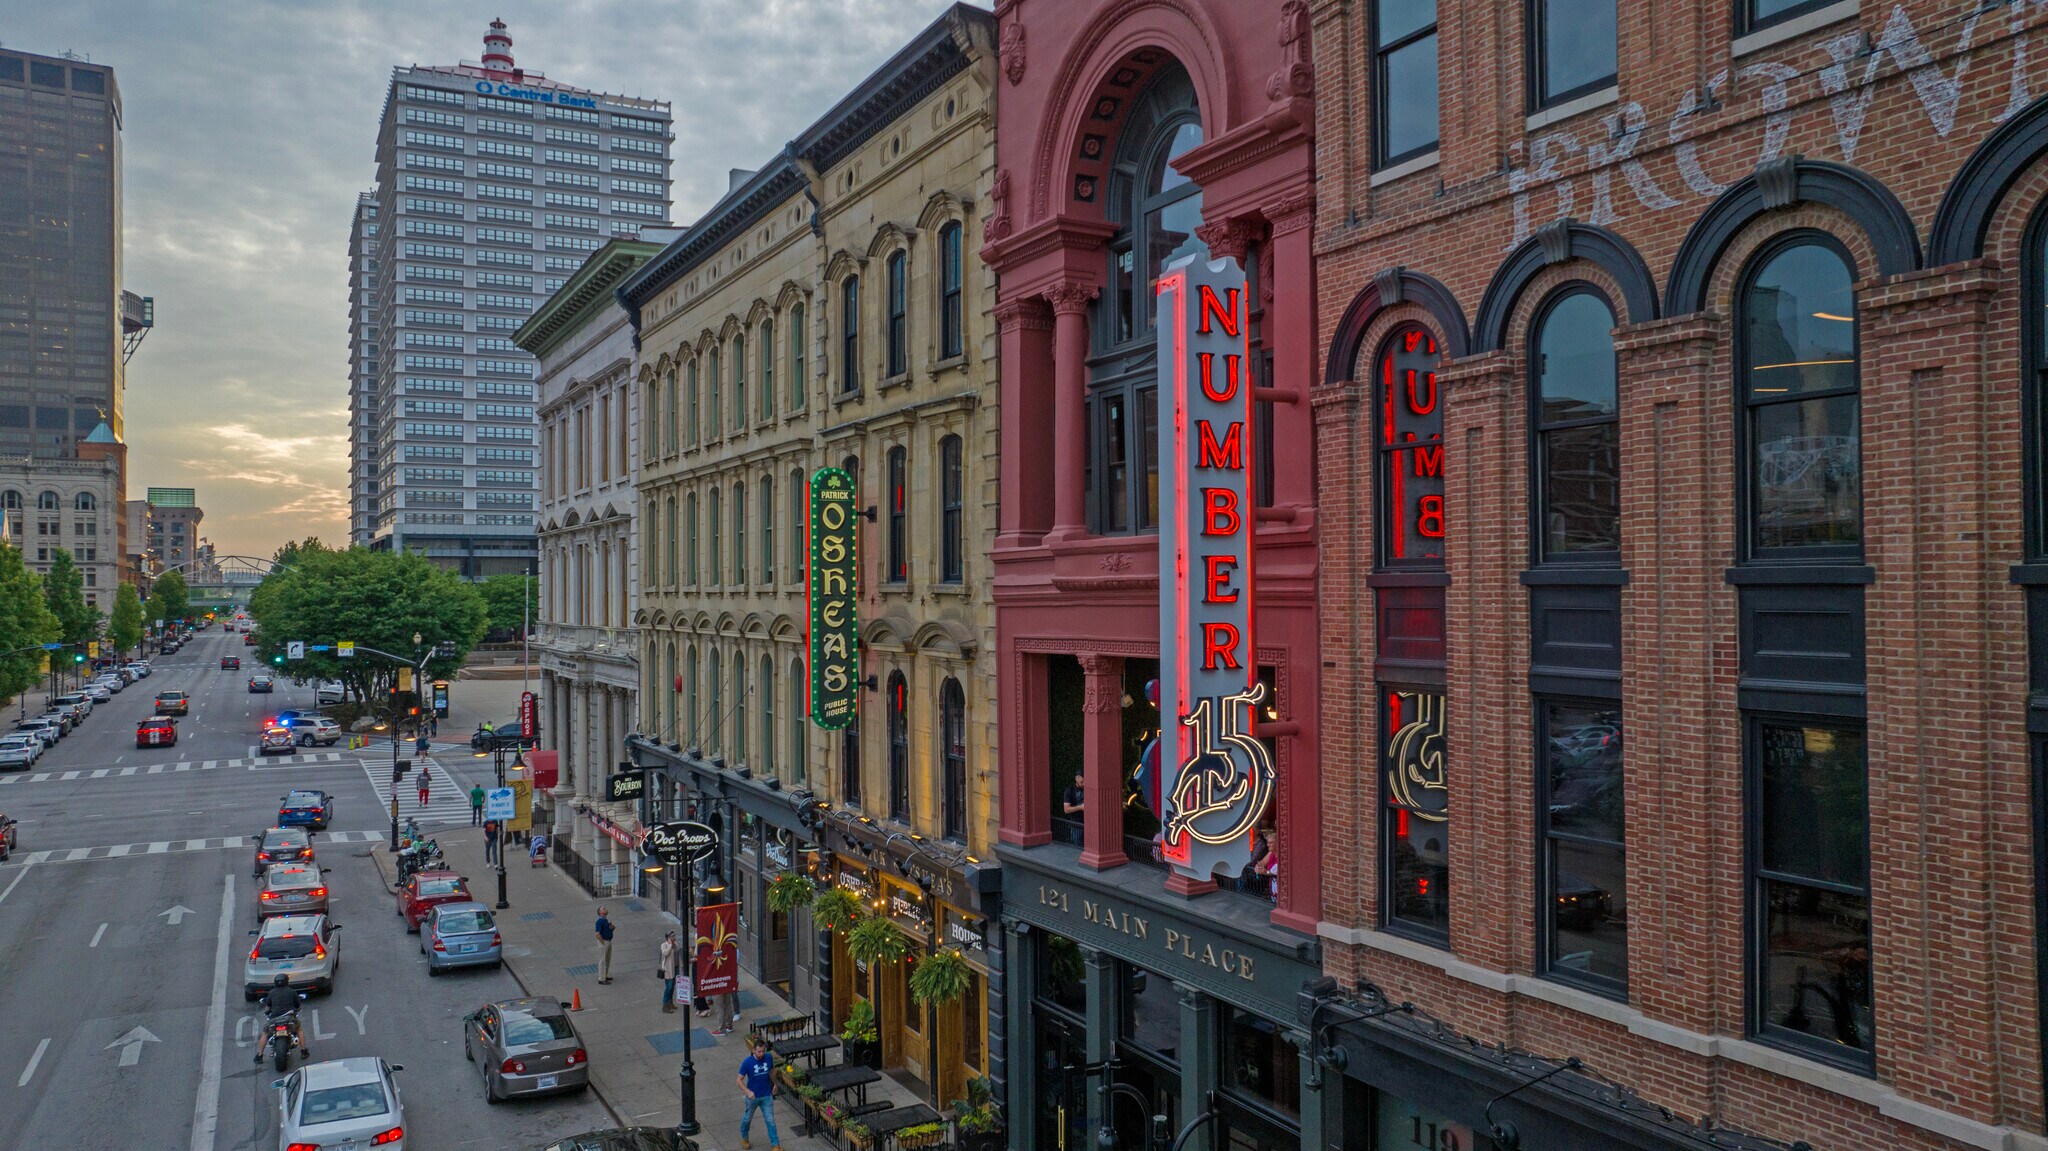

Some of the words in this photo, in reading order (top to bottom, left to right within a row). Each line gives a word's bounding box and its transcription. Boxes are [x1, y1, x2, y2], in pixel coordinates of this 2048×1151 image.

[498, 83, 553, 103] Central
[558, 93, 597, 109] Bank
[1195, 284, 1245, 672] NUMBER
[821, 491, 849, 500] PATRICK
[824, 698, 848, 711] PUBLIC
[825, 706, 848, 718] HOUSE
[1164, 682, 1276, 846] 15
[654, 830, 676, 845] Doc
[1038, 885, 1069, 913] 121
[1083, 900, 1149, 940] MAIN
[1163, 927, 1255, 981] PLACE
[701, 975, 732, 985] Downtown
[701, 982, 728, 991] Louisville
[235, 1004, 368, 1047] OLY
[1410, 1115, 1459, 1151] 119
